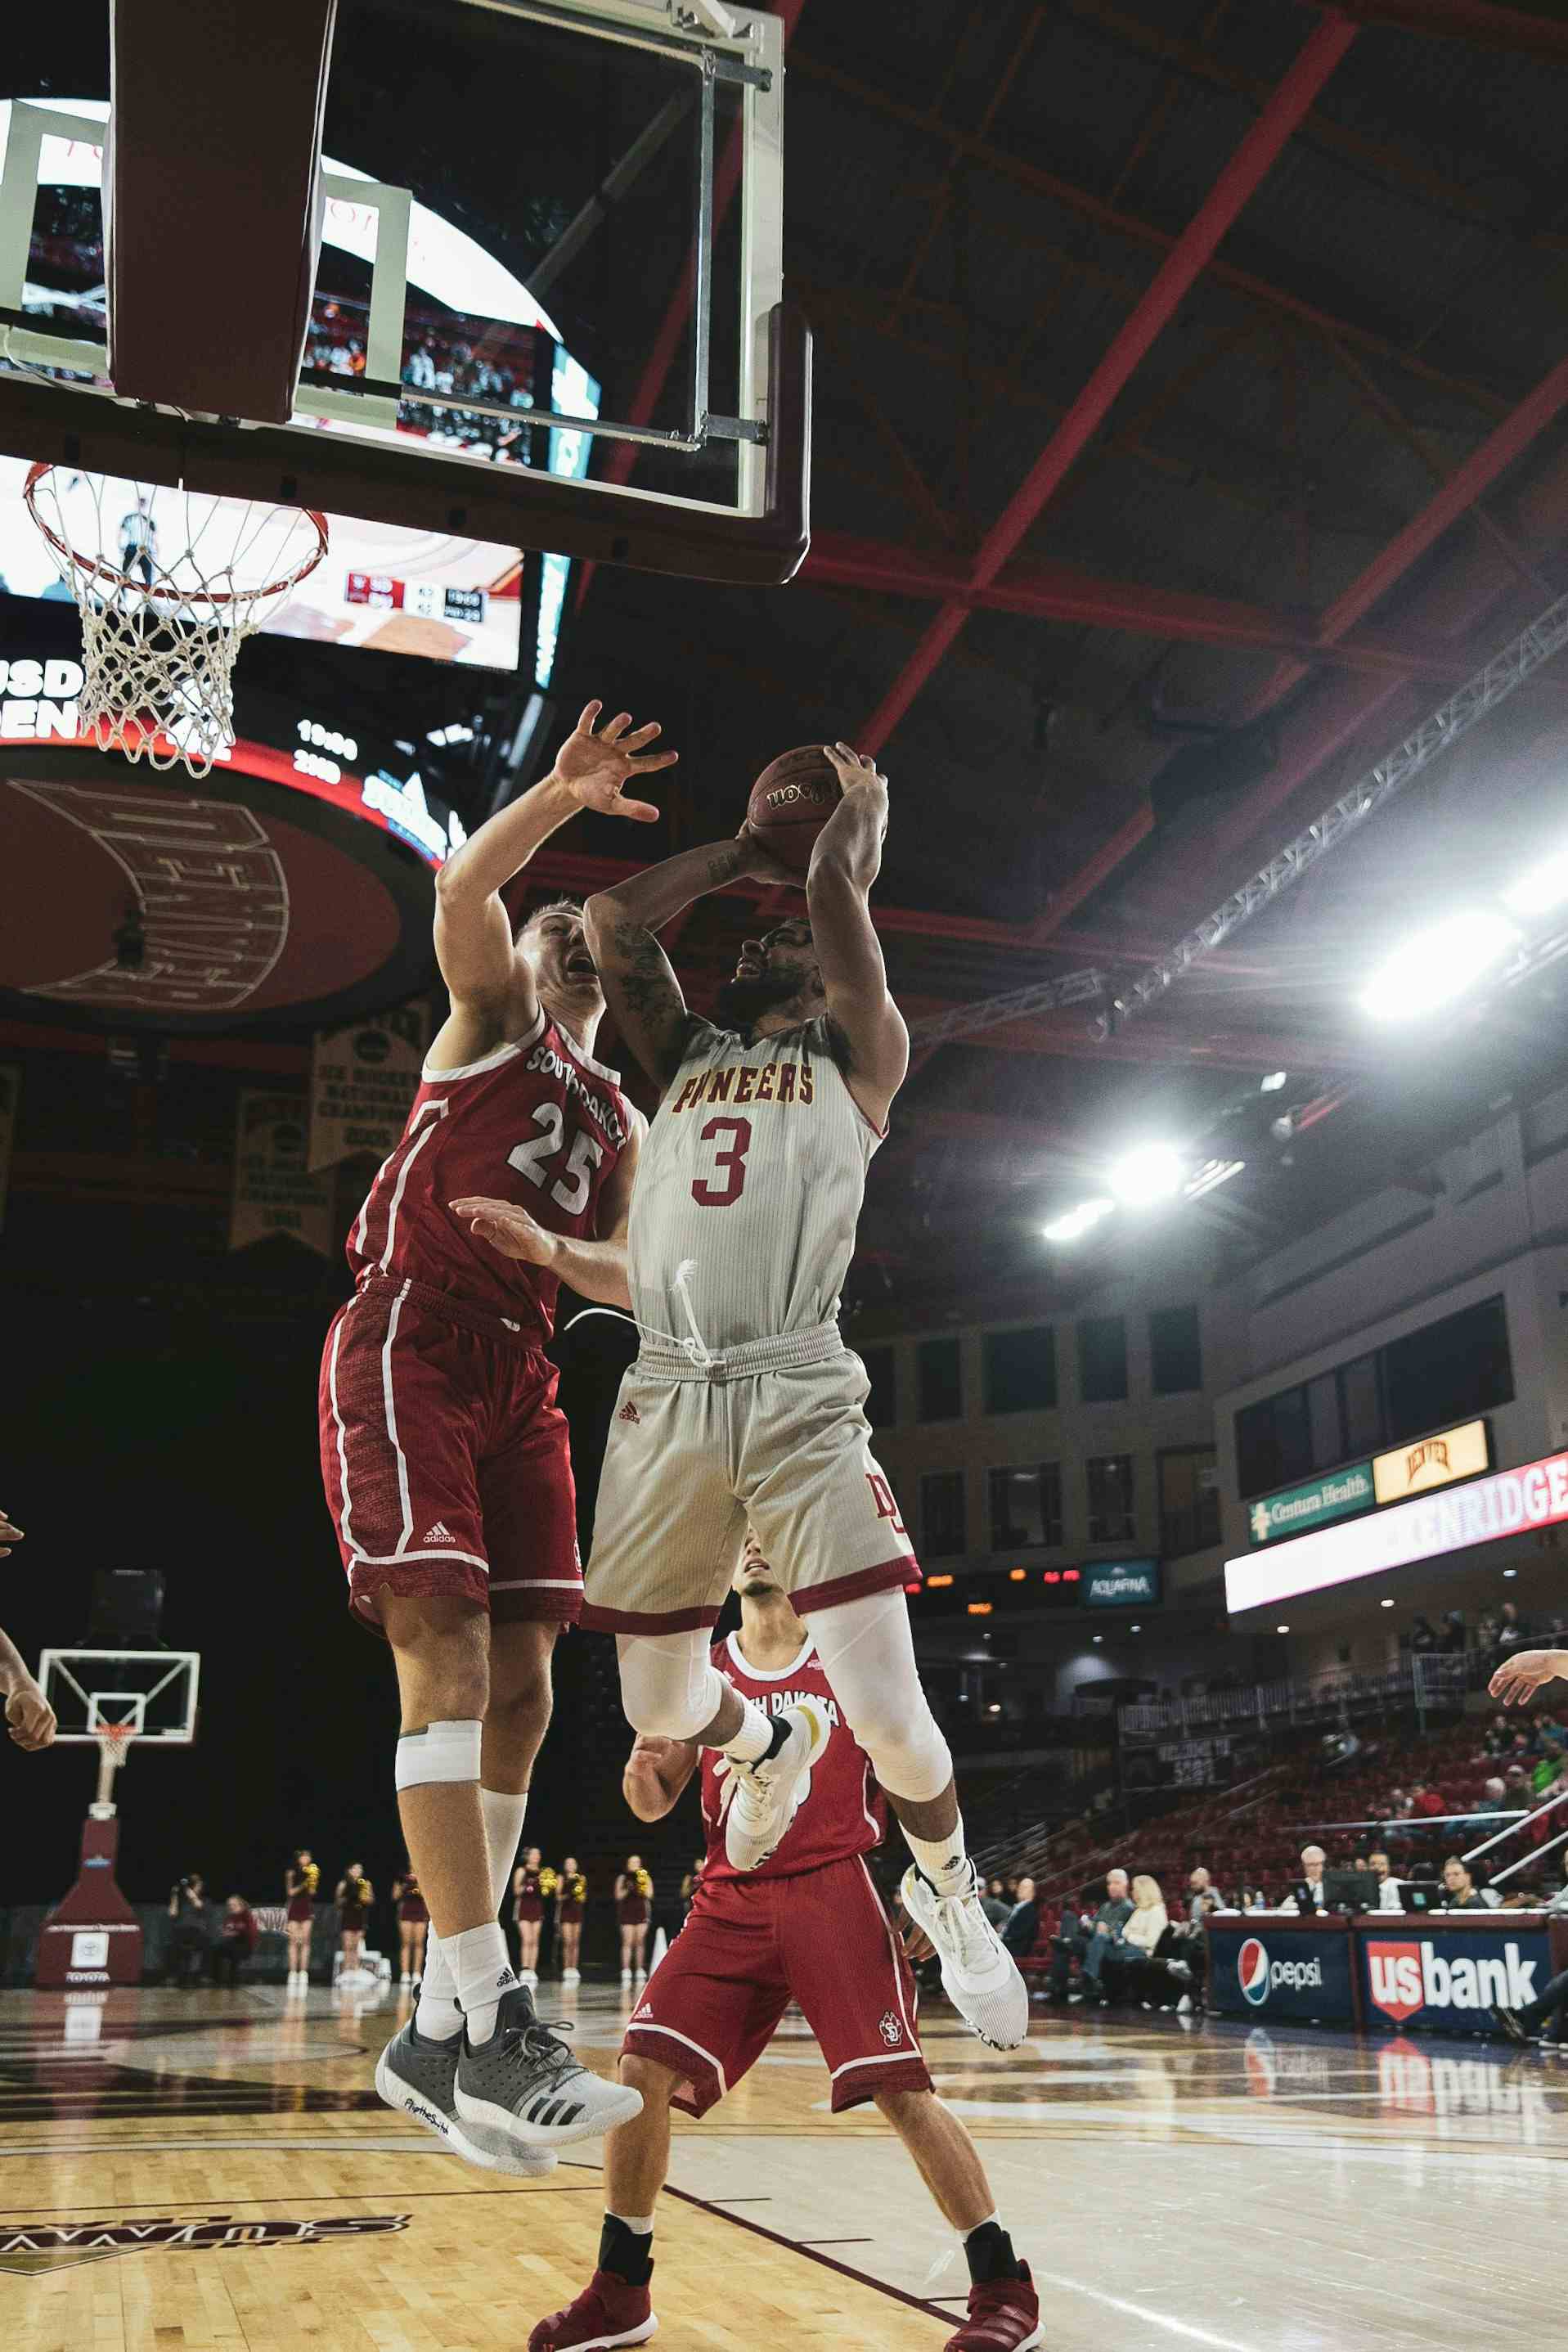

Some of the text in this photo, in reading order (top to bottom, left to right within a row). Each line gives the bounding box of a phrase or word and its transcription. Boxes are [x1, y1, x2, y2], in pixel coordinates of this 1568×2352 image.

[0, 659, 83, 697] SD
[0, 699, 81, 739] EN
[669, 1062, 814, 1115] PINEERS
[507, 1102, 604, 1216] 25
[691, 1117, 752, 1207] 3
[1271, 1474, 1369, 1523] Centura Health
[423, 1535, 456, 1543] adidas
[1090, 1576, 1151, 1597] AQUAFINA
[65, 1972, 110, 1983] TOYOTA
[1270, 1958, 1322, 1992] pepsi
